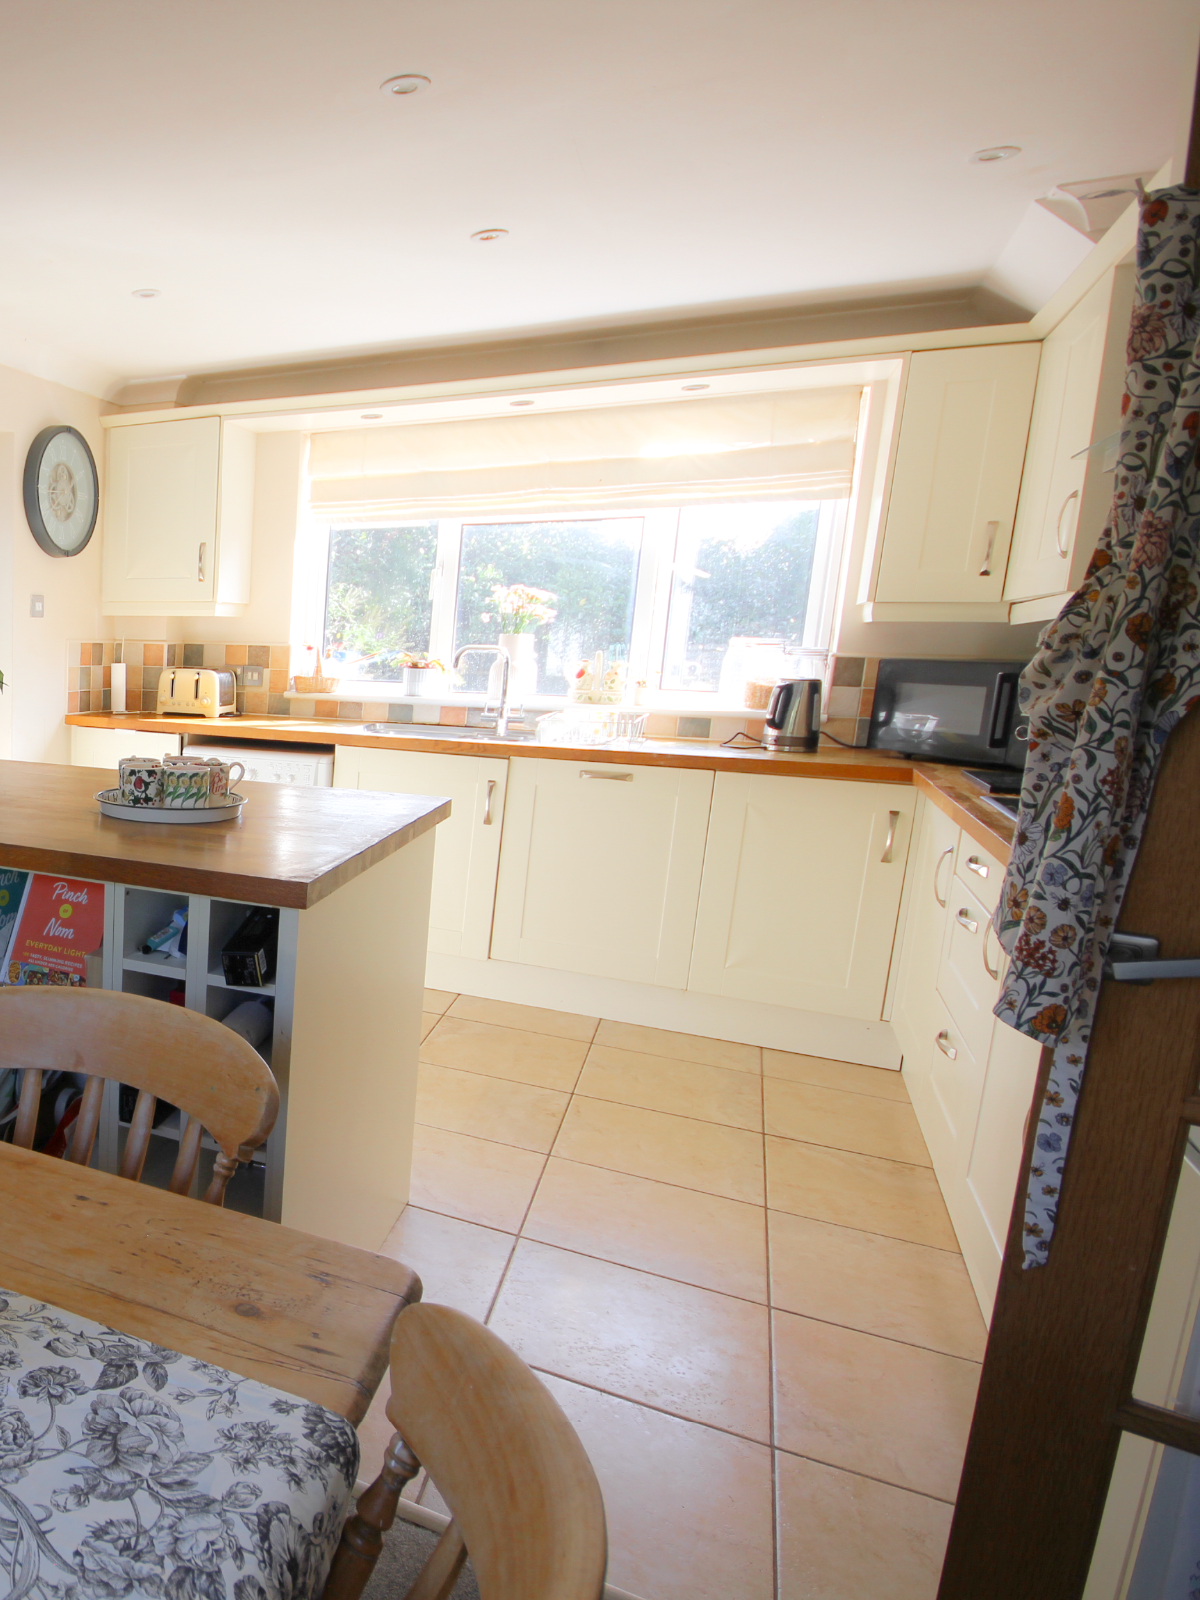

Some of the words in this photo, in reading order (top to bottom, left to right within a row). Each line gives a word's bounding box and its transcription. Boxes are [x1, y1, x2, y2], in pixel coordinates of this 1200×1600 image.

[52, 881, 89, 905] Pinch
[43, 917, 75, 940] Nom
[25, 939, 63, 954] EVERYDAY
[63, 947, 87, 960] LIGHT
